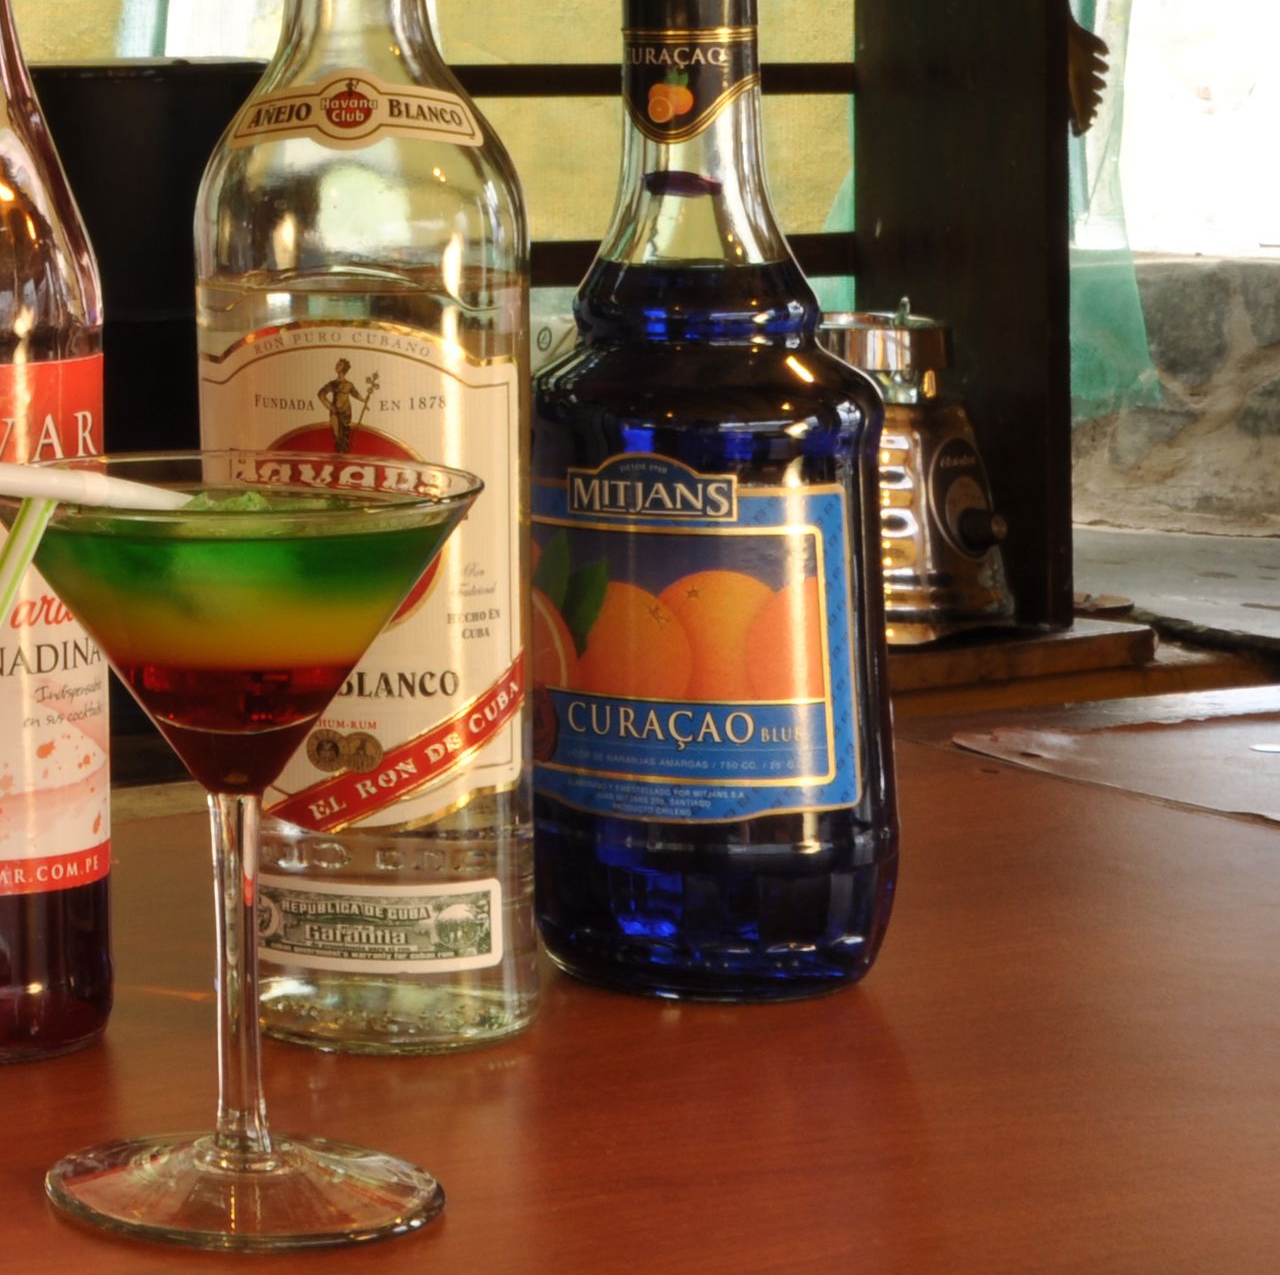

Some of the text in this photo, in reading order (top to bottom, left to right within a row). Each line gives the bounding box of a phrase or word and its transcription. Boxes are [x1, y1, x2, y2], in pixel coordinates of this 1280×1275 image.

[320, 97, 378, 110] Havana
[387, 97, 464, 126] BLANCO
[246, 99, 312, 128] AÑEJO
[331, 109, 365, 123] Club
[252, 330, 431, 358] RON PURO CUBANO
[254, 394, 447, 412] FUNDADA EN 1878
[573, 477, 730, 517] MITJANS
[446, 608, 501, 625] HECHO EN
[461, 628, 491, 640] CUBA
[46, 713, 65, 726] sus
[568, 700, 803, 751] CURAÇAO BLUE
[308, 679, 520, 822] EL RON DE CUBA
[606, 754, 657, 767] NARANJAS
[658, 757, 709, 770] AMARGAS
[614, 783, 672, 797] EMBOTELLADO
[673, 788, 691, 798] POR
[692, 789, 729, 800] MITJANS
[611, 802, 693, 818] PRODUCTO CHILENO
[669, 798, 713, 809] SANTIAGO
[281, 899, 432, 921] REPUBLICA DE CUBA
